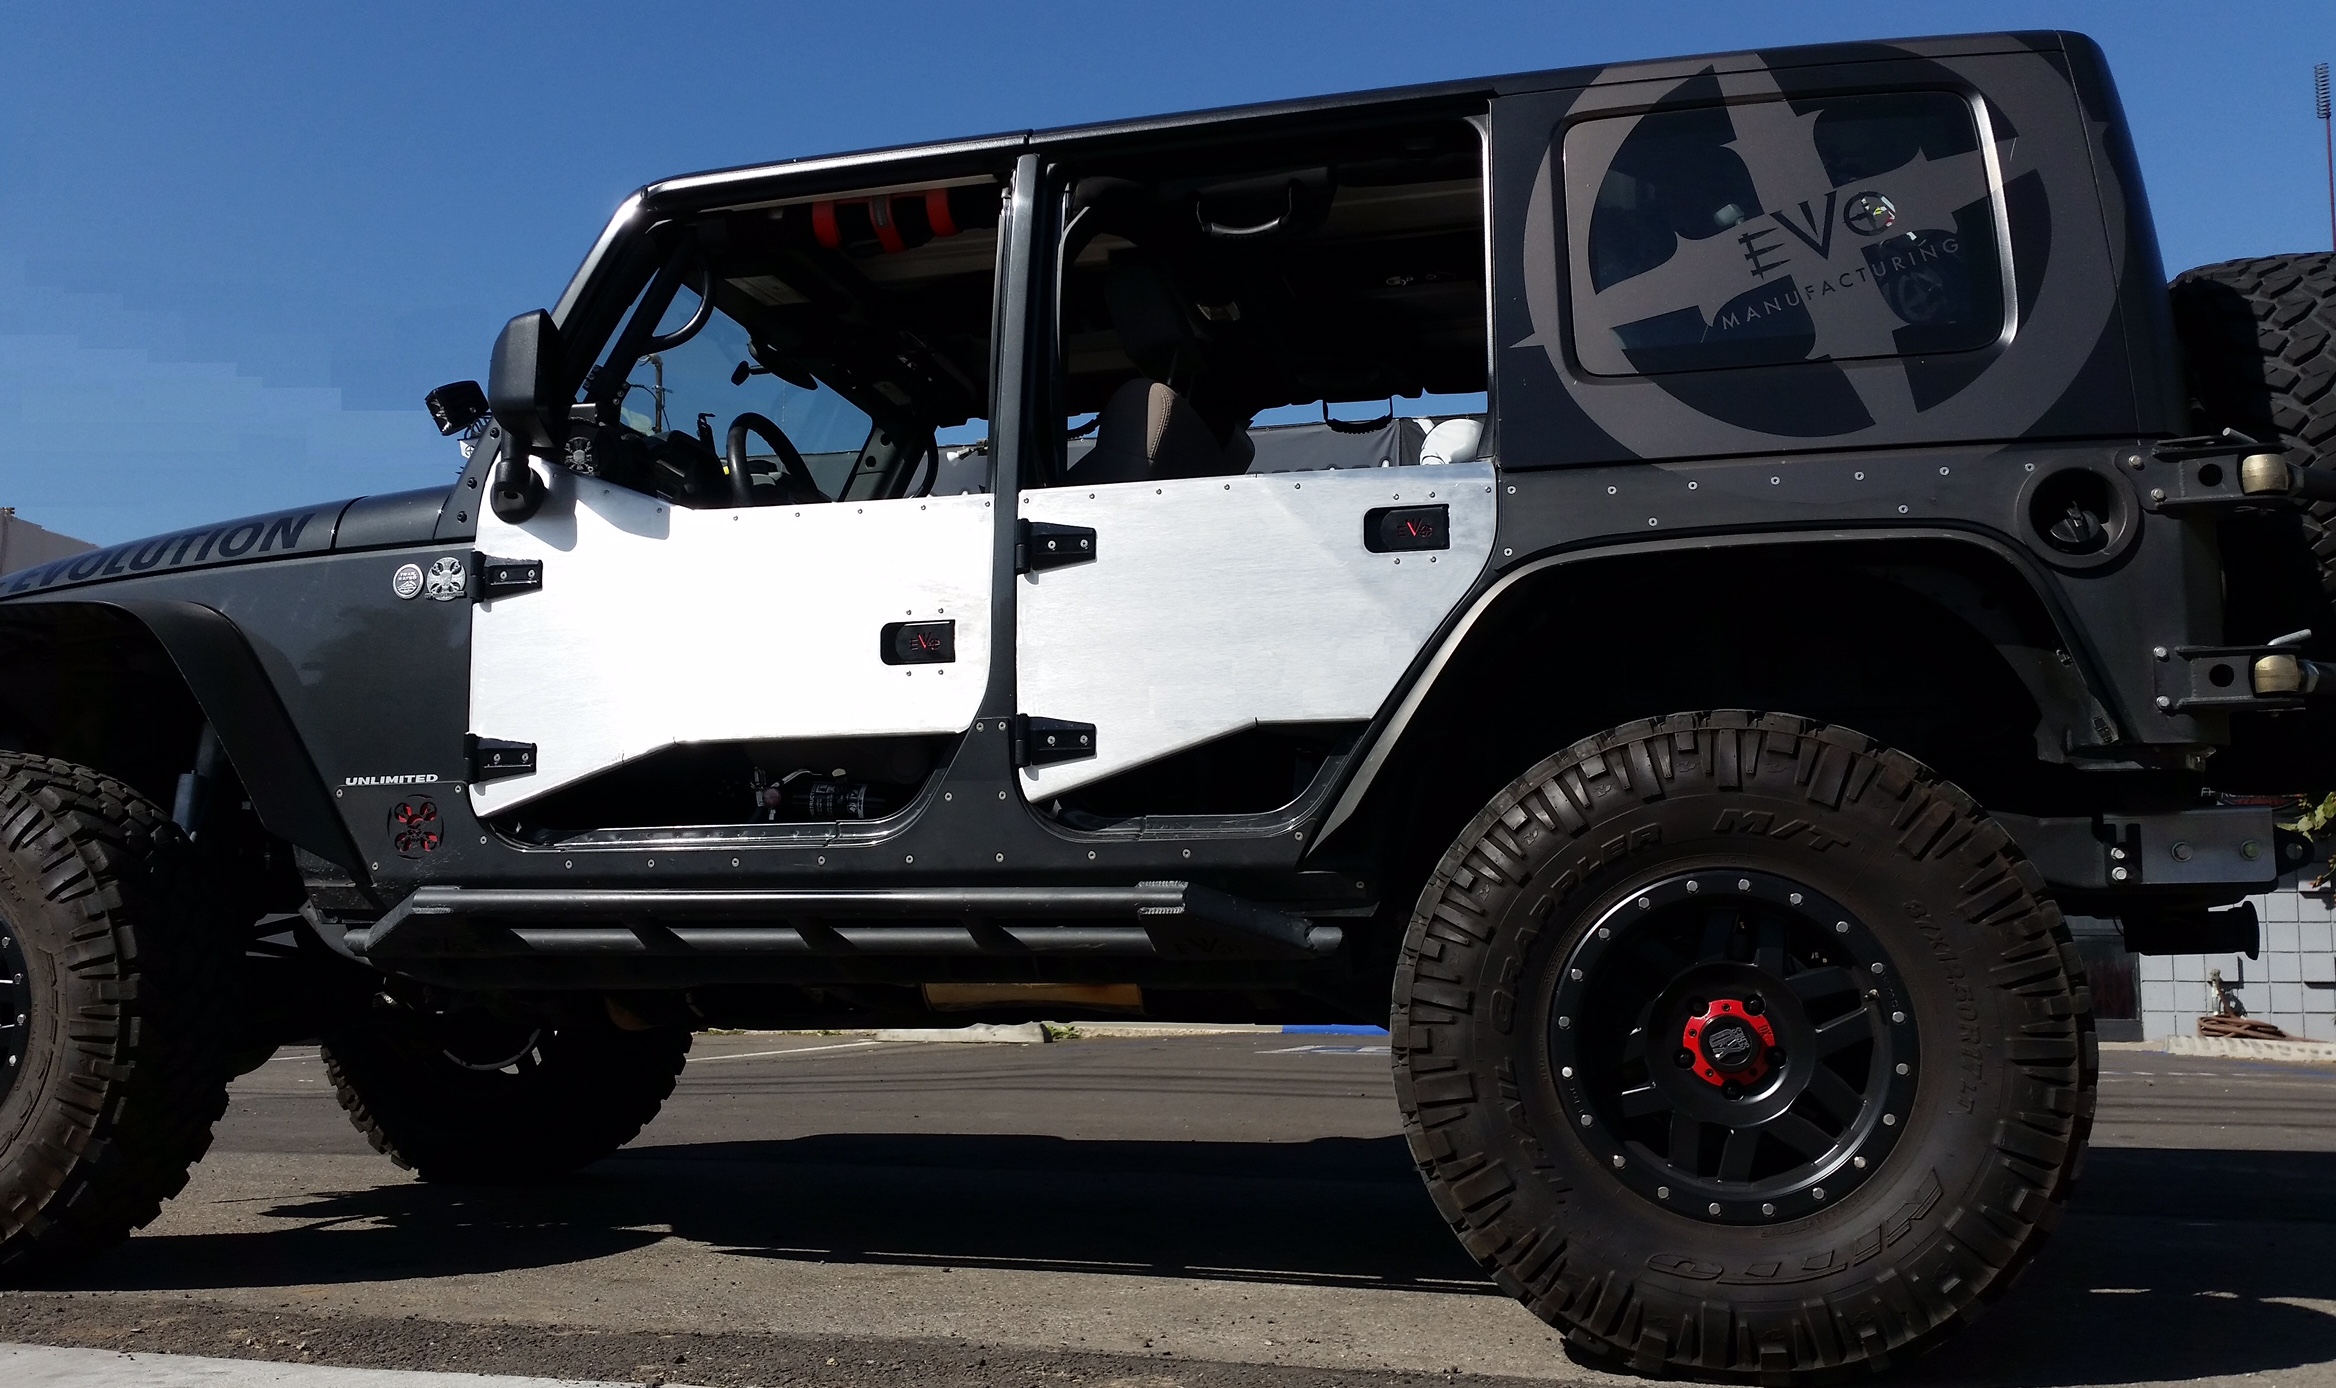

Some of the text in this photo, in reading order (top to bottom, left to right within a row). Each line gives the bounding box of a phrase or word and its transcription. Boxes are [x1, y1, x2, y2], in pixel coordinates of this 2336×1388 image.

[1738, 190, 1896, 280] EVO
[1721, 238, 1959, 331] MANUFACTURING
[8, 513, 316, 593] EVOLUTION
[1397, 518, 1433, 538] EVO
[909, 632, 941, 652] EVO
[345, 773, 439, 786] UNLIMITED
[1490, 823, 1664, 1035] GRAPPLER
[1713, 808, 1851, 852] M/T
